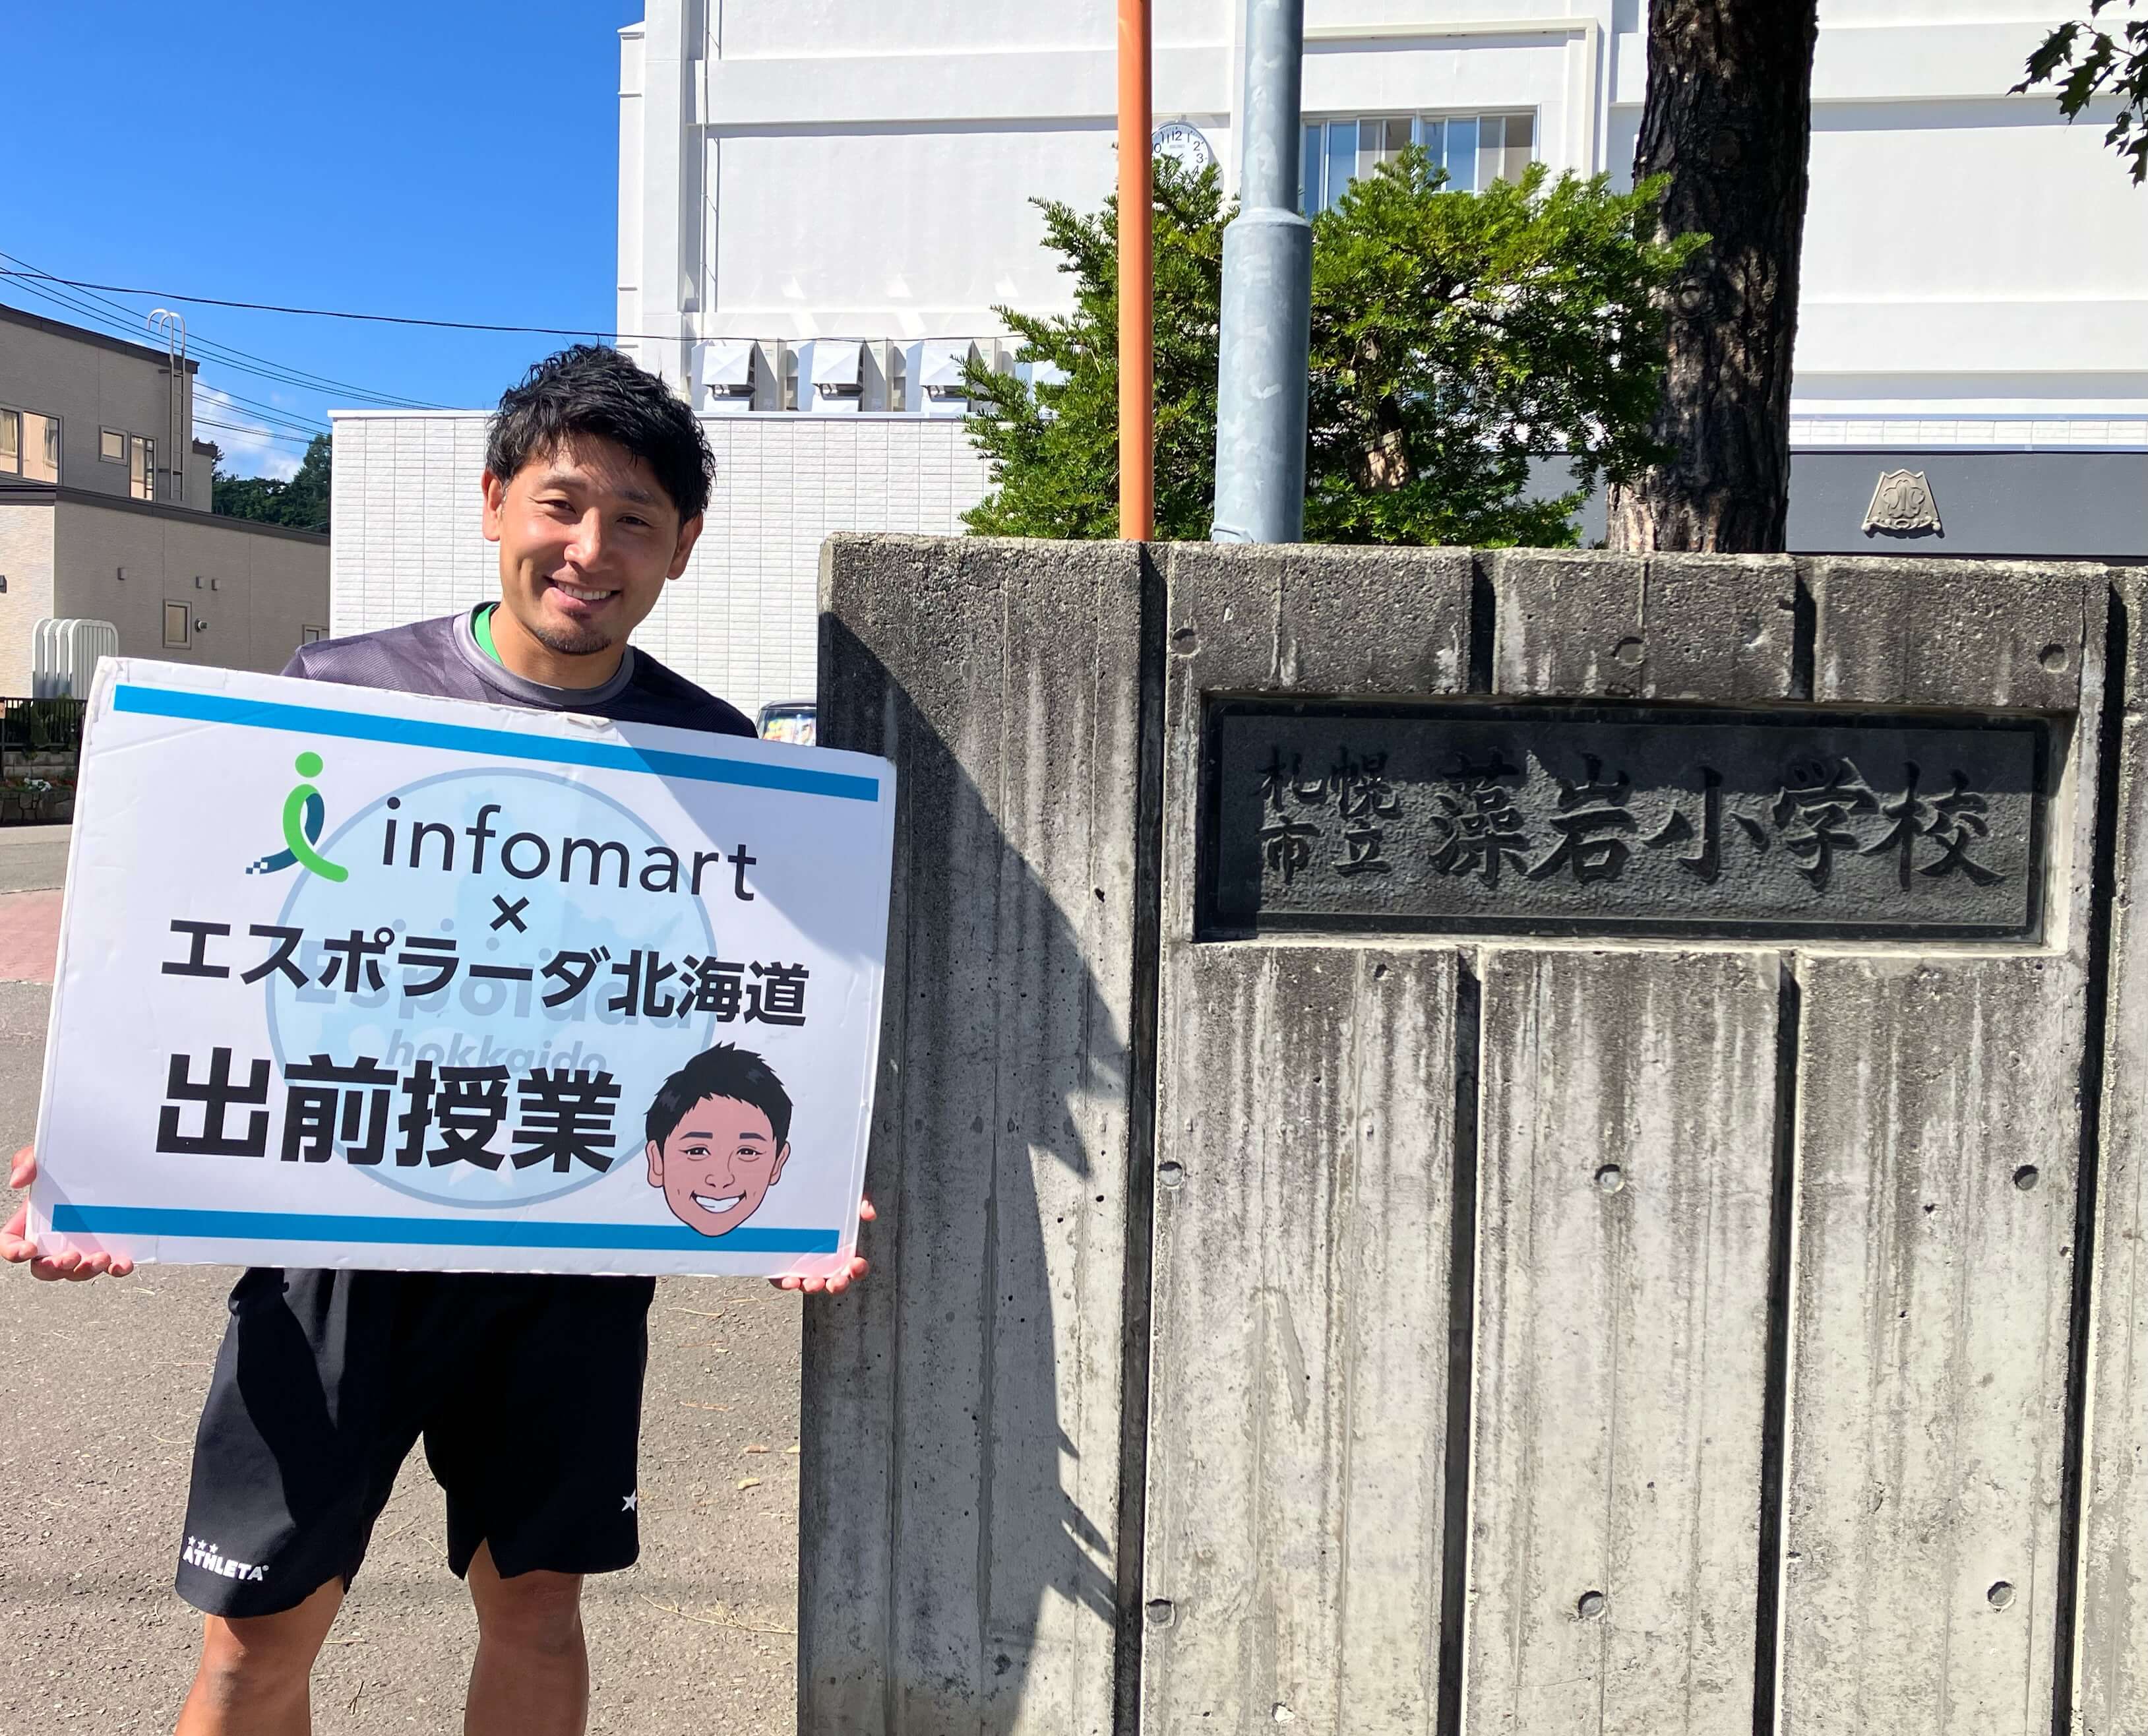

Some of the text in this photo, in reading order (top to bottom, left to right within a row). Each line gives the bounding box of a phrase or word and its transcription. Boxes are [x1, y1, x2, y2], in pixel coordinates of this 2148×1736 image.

[1172, 131, 1182, 141] 12
[1193, 141, 1200, 151] 2
[1196, 153, 1204, 164] 3
[382, 797, 757, 901] infomart
[162, 919, 809, 1026] エスポラーダ北海道
[156, 1047, 622, 1173] 出前授業
[183, 1545, 263, 1581] ATHLETA
